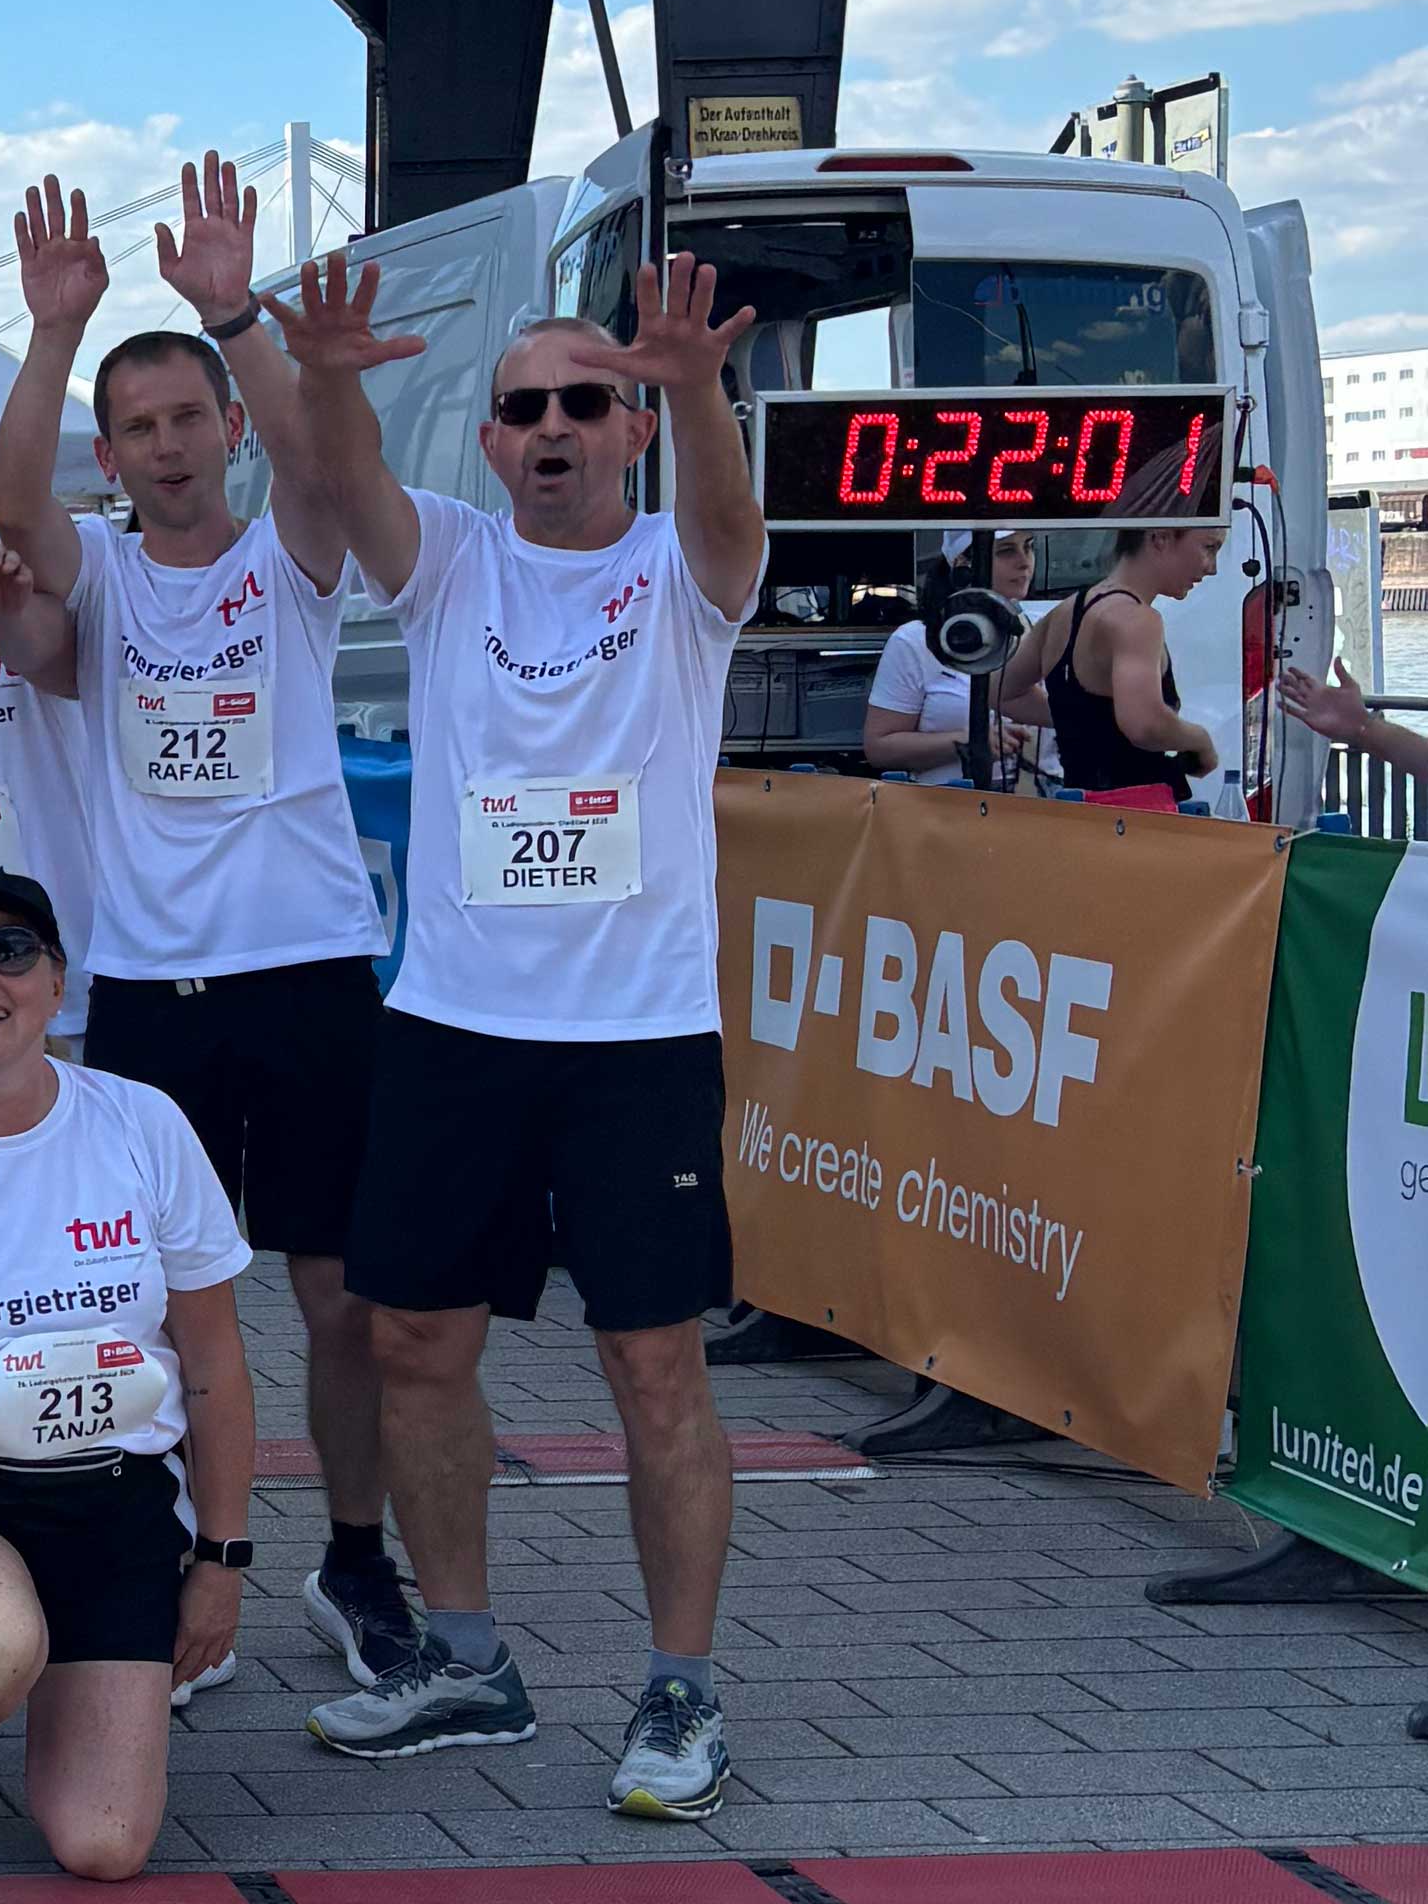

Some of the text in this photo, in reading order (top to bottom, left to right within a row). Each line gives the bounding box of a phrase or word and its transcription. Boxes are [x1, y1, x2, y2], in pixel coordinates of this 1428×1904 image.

[700, 106, 722, 122] Der
[840, 410, 1206, 503] 0:22:01
[137, 694, 166, 711] twl
[160, 728, 226, 759] 212
[149, 762, 240, 781] RAFAEL
[481, 794, 518, 813] twl
[511, 829, 586, 864] 207
[503, 866, 597, 888] DIETER
[856, 915, 1113, 1128] BASF
[739, 1099, 1084, 1302] We create chemistry
[66, 1210, 140, 1252] twl
[3, 1350, 45, 1372] twl
[39, 1382, 113, 1422] 213
[32, 1417, 116, 1444] TANJA
[1272, 1406, 1423, 1512] lunited.de
